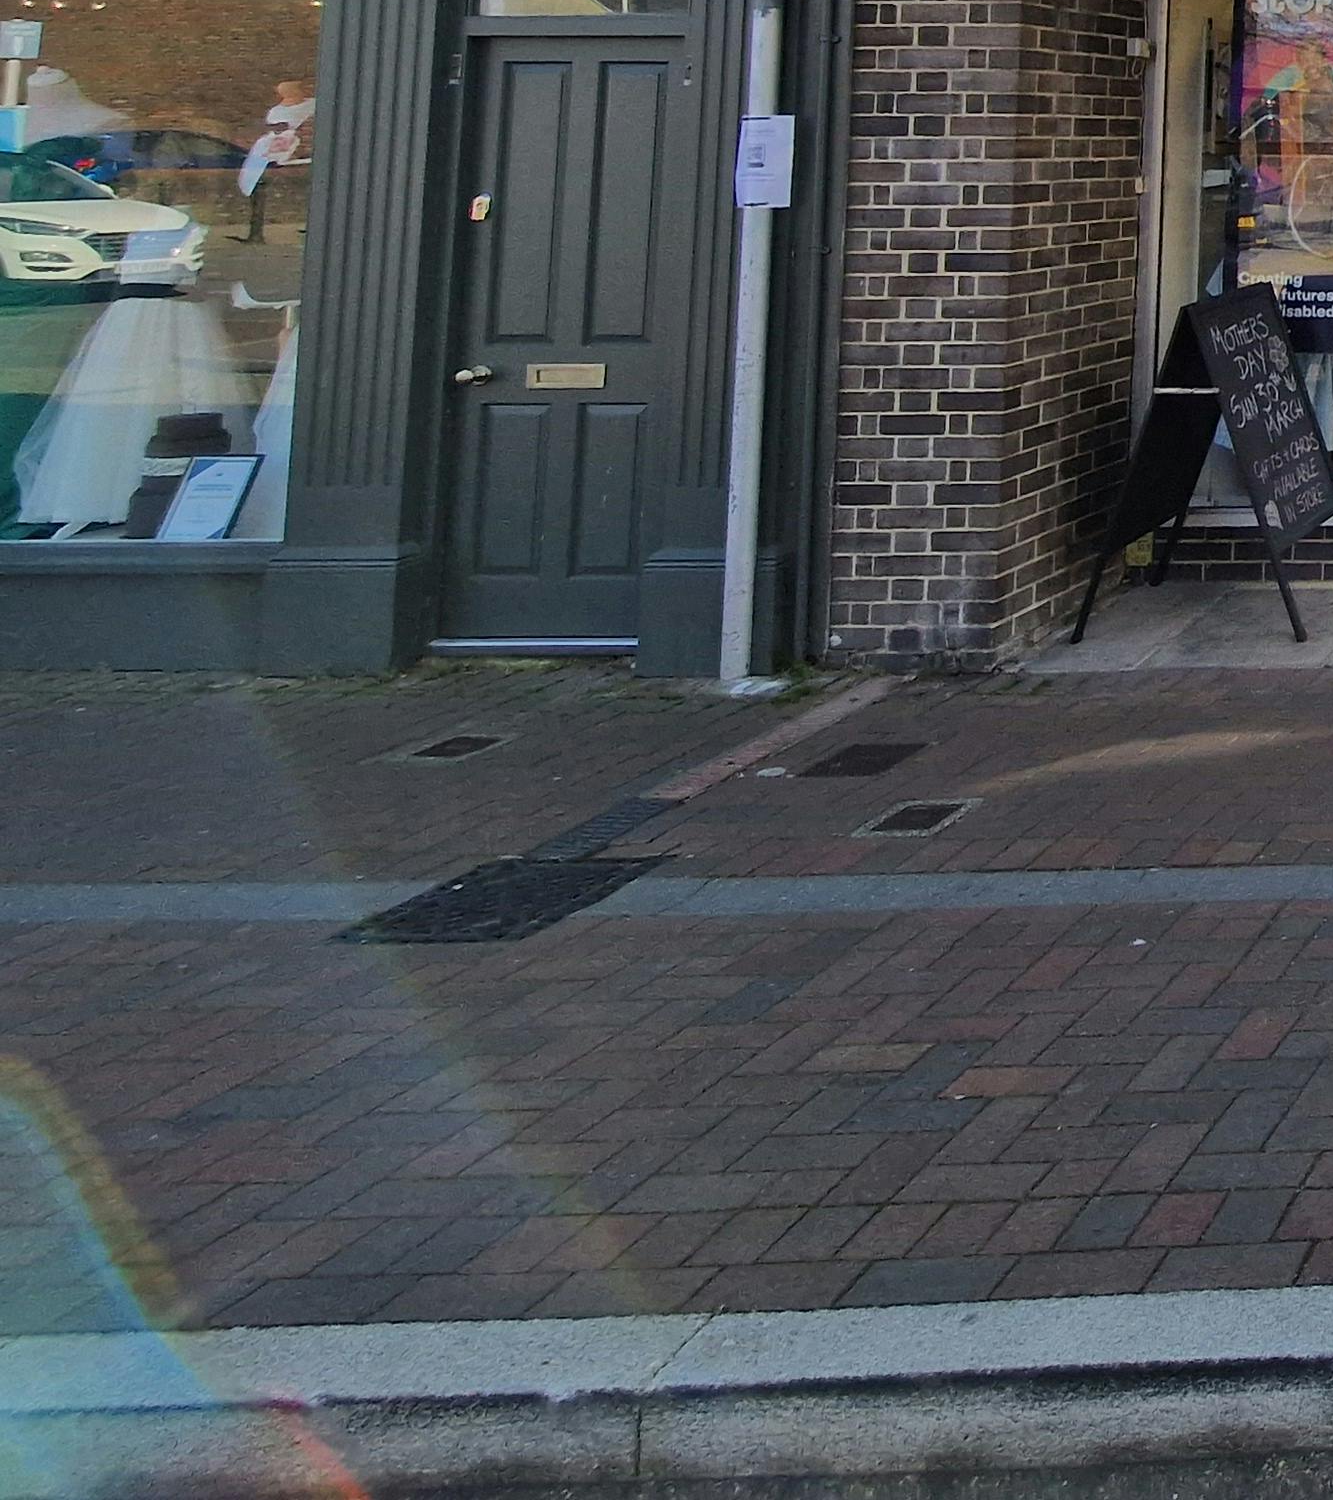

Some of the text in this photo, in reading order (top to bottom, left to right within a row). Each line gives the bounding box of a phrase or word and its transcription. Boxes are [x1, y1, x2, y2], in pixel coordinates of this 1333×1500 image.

[1238, 271, 1303, 288] Creating
[1209, 312, 1270, 355] MOTHERS
[1233, 342, 1268, 381] DAY
[1263, 397, 1305, 444] MARCH
[1272, 457, 1320, 501] AVAILABLE
[1283, 482, 1326, 524] IN STORE
